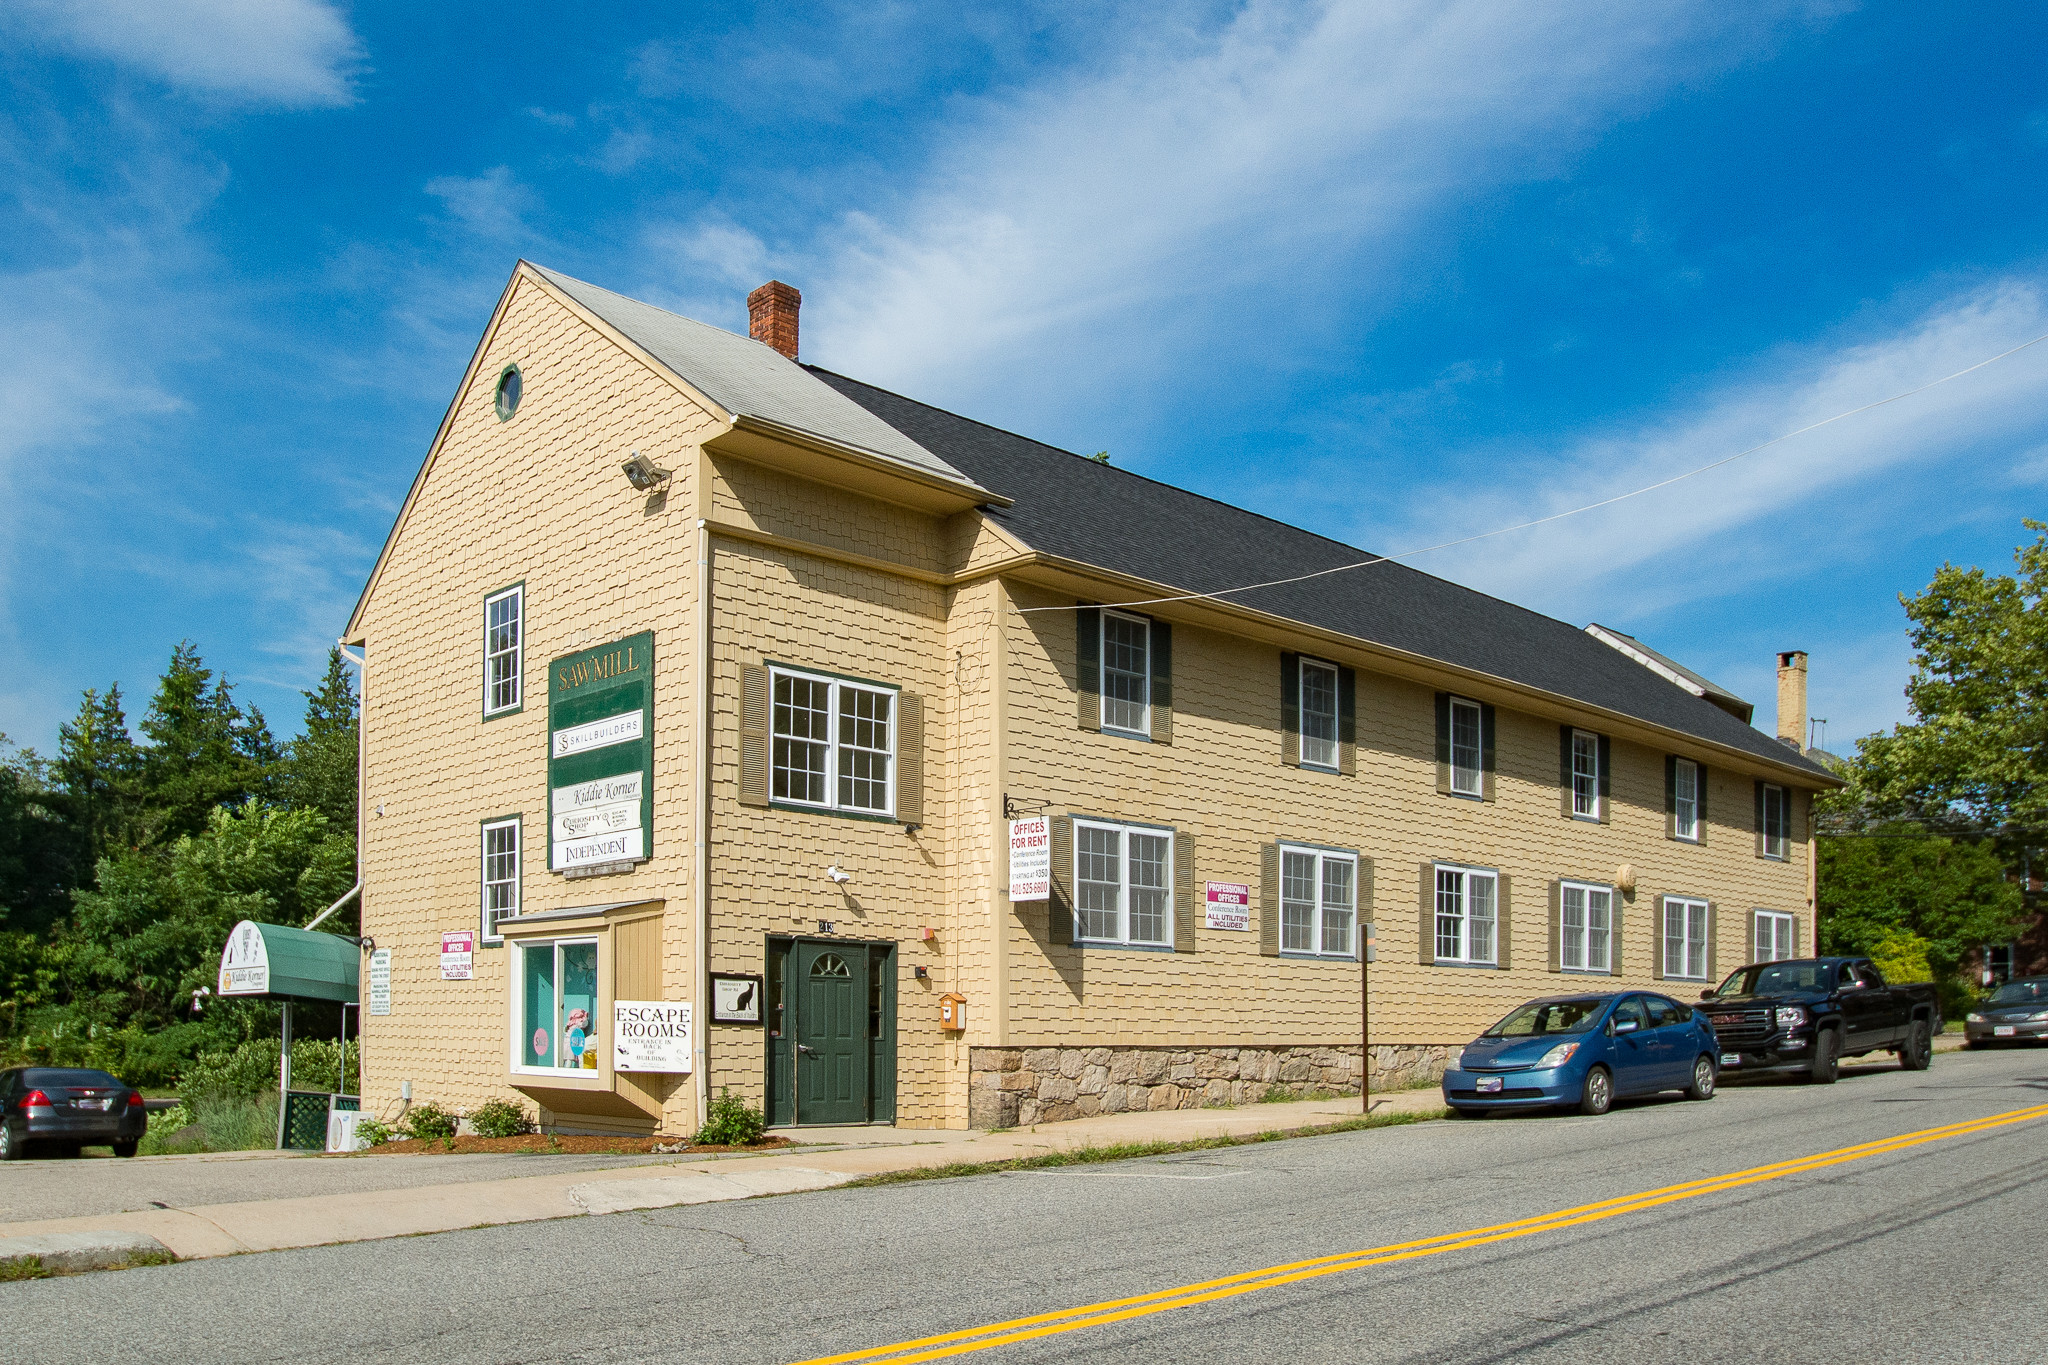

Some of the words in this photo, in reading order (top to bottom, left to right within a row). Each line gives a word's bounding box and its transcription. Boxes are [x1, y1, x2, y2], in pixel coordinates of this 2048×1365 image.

[559, 647, 639, 691] SAWMILL
[571, 721, 638, 745] SKILLBUILDERS
[574, 783, 602, 806] Kiddie
[605, 782, 637, 800] Korner
[1014, 822, 1044, 835] OFFICES
[1012, 838, 1026, 848] FOR
[1028, 835, 1047, 848] RENT
[566, 837, 627, 862] INDEPENDENT
[1012, 872, 1029, 880] STARTING
[1012, 881, 1047, 894] 401-525-6600
[1208, 883, 1247, 894] PROFESSIONAL
[1218, 894, 1240, 903] OFFICES
[1208, 903, 1234, 912] Conference
[820, 922, 833, 932] 213
[448, 943, 464, 952] OFFICES
[232, 970, 247, 984] Kiddie
[248, 970, 264, 982] Korner
[616, 1008, 690, 1022] ESCAPE
[622, 1022, 686, 1038] ROOMS
